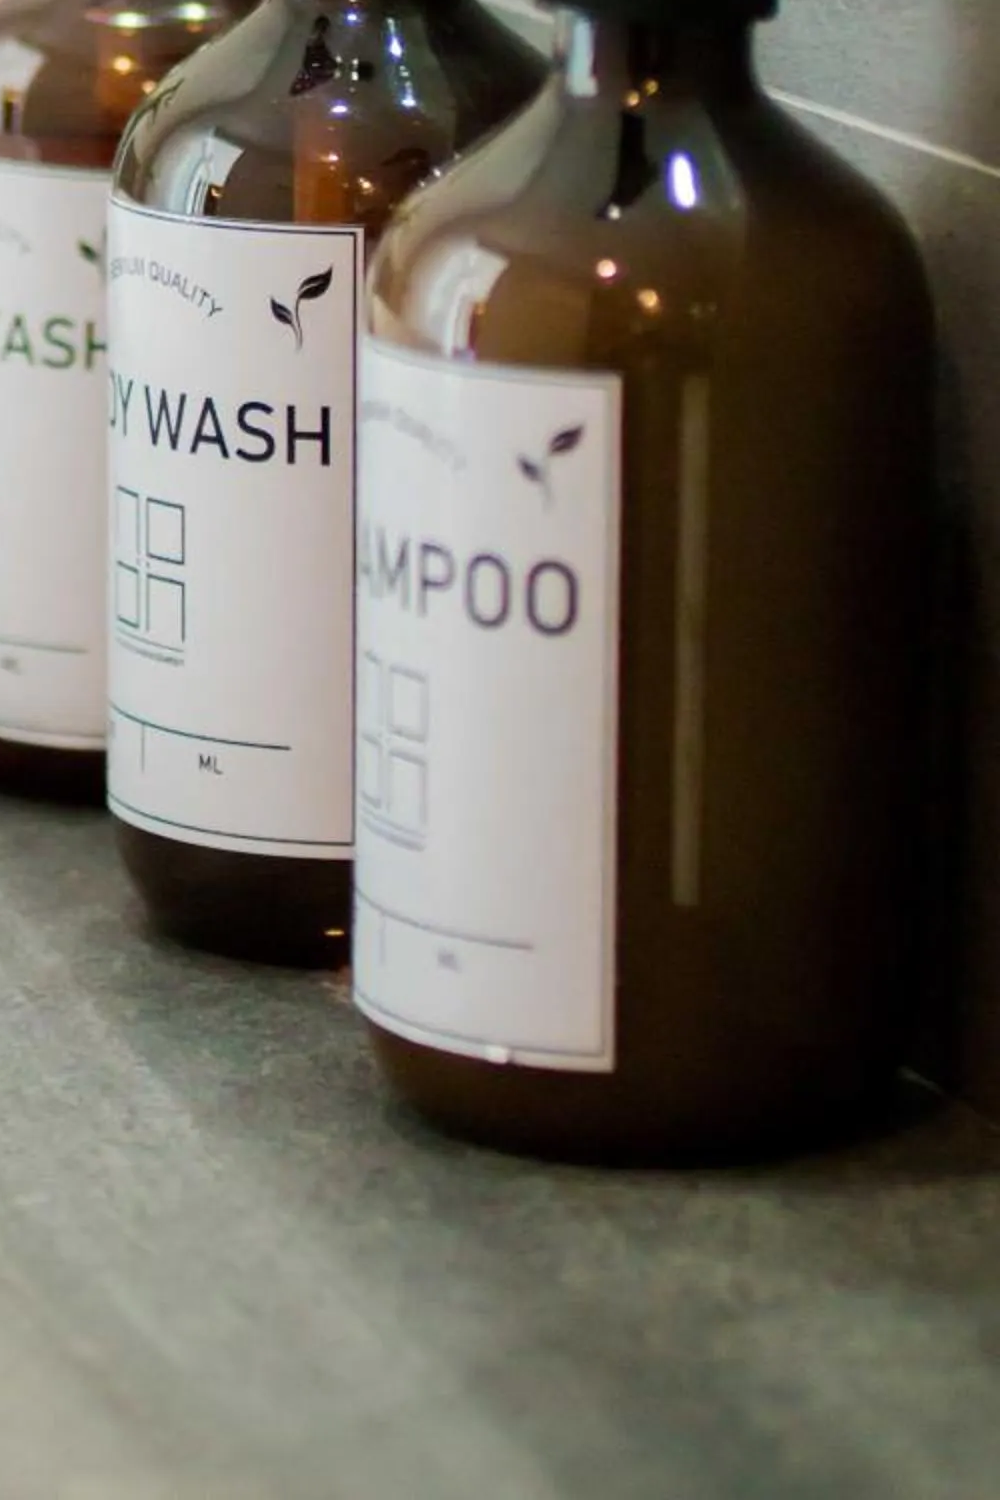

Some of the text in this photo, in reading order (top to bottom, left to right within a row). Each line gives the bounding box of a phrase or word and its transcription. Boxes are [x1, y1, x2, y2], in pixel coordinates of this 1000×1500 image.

[149, 260, 223, 318] QUALITY
[144, 384, 331, 467] WASH
[199, 752, 224, 776] ML
